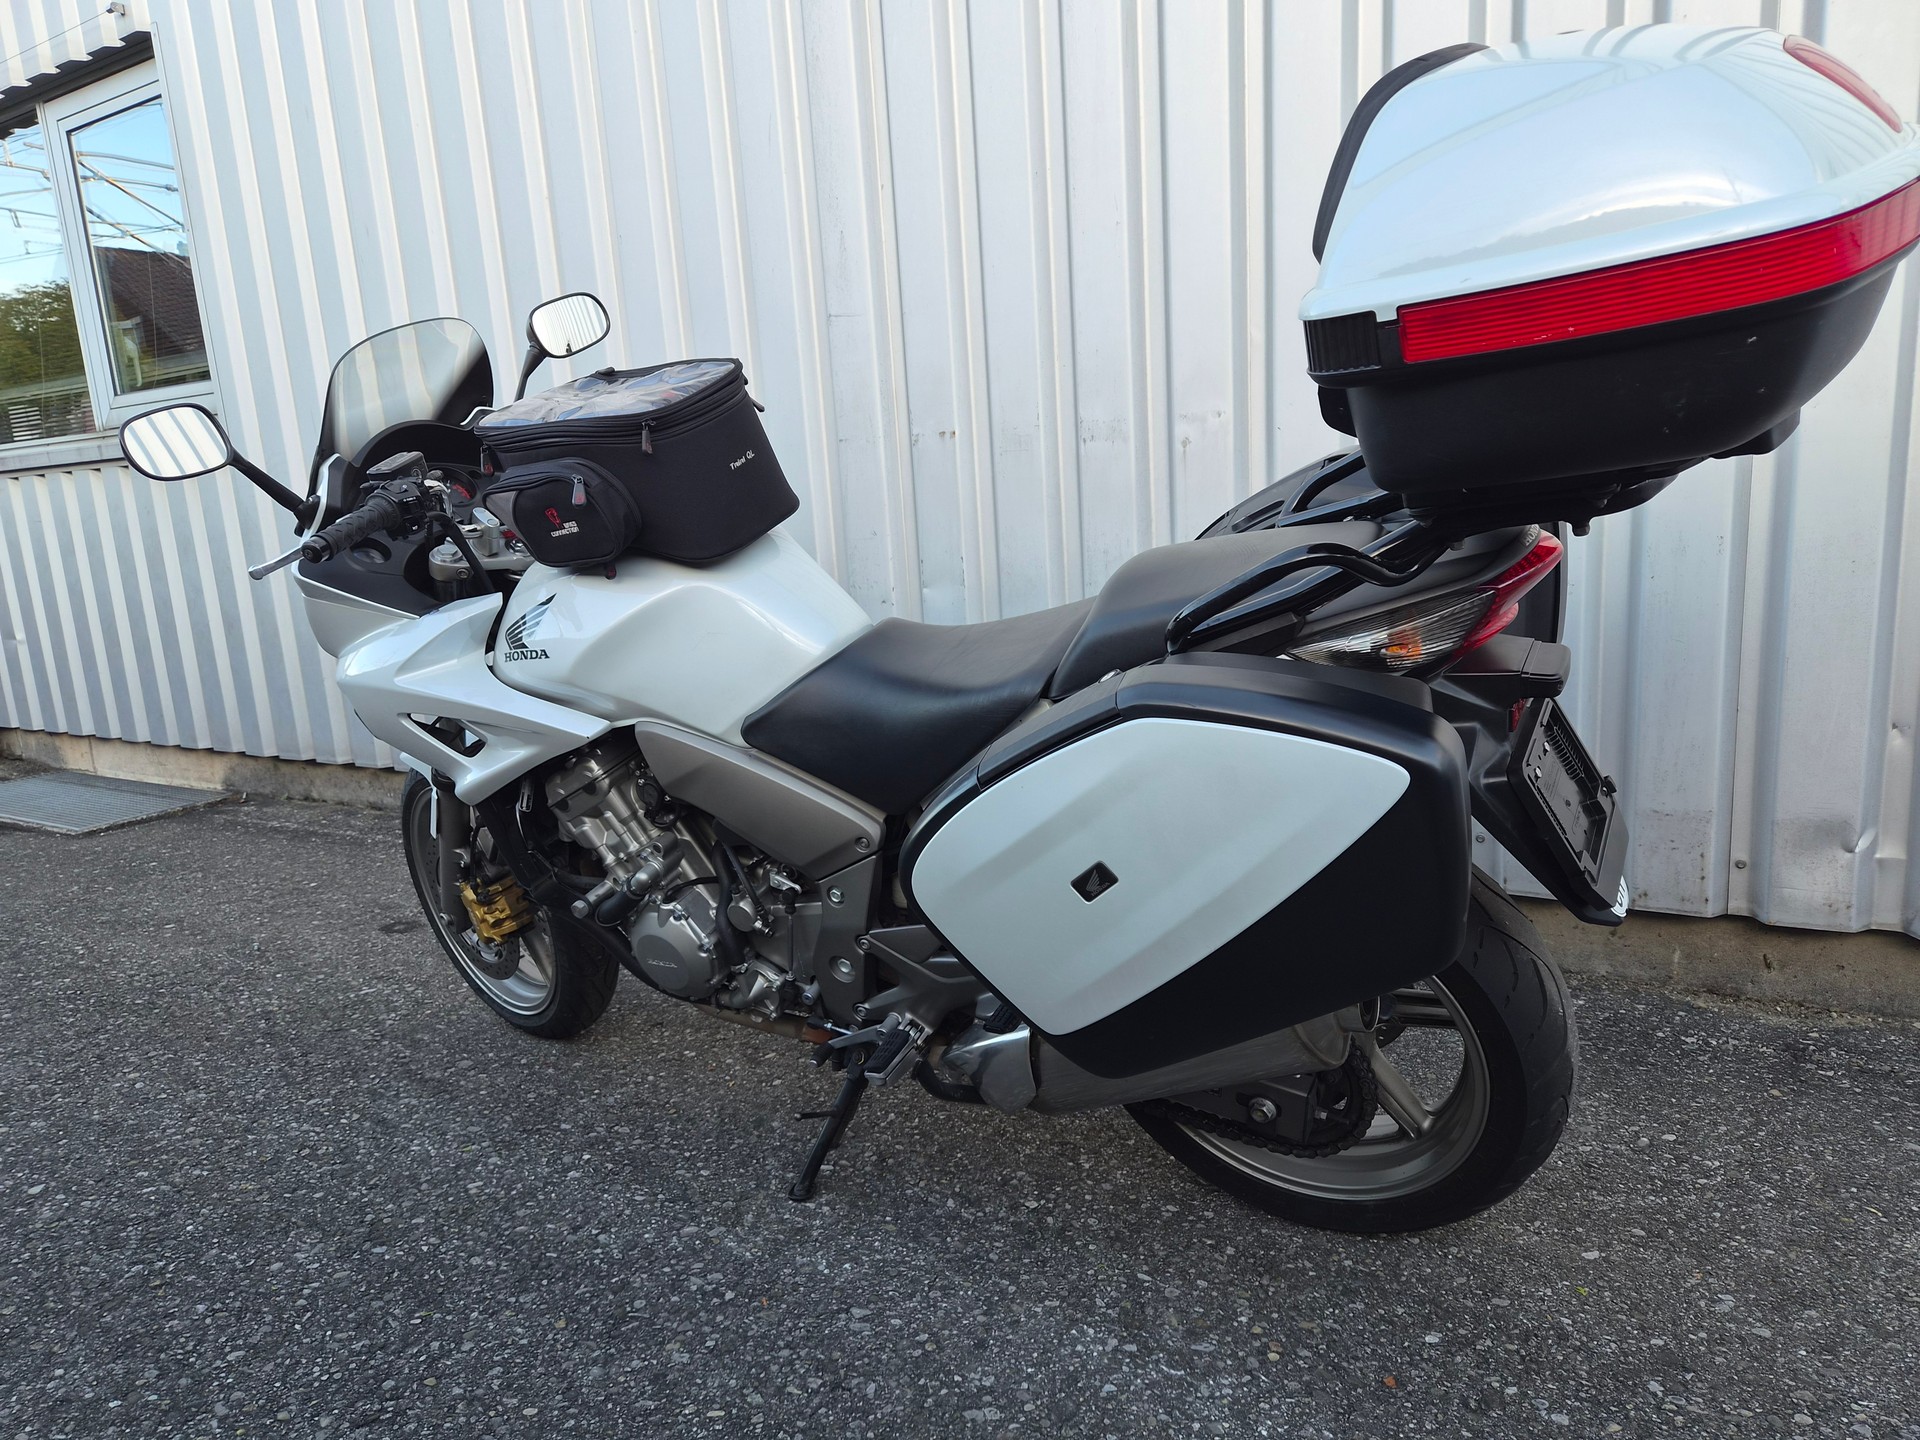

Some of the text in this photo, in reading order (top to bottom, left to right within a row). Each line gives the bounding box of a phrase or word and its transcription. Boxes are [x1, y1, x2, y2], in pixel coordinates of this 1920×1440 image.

[551, 526, 579, 537] CONNECTION
[504, 648, 550, 663] HONDA
[1091, 882, 1110, 896] HONDA
